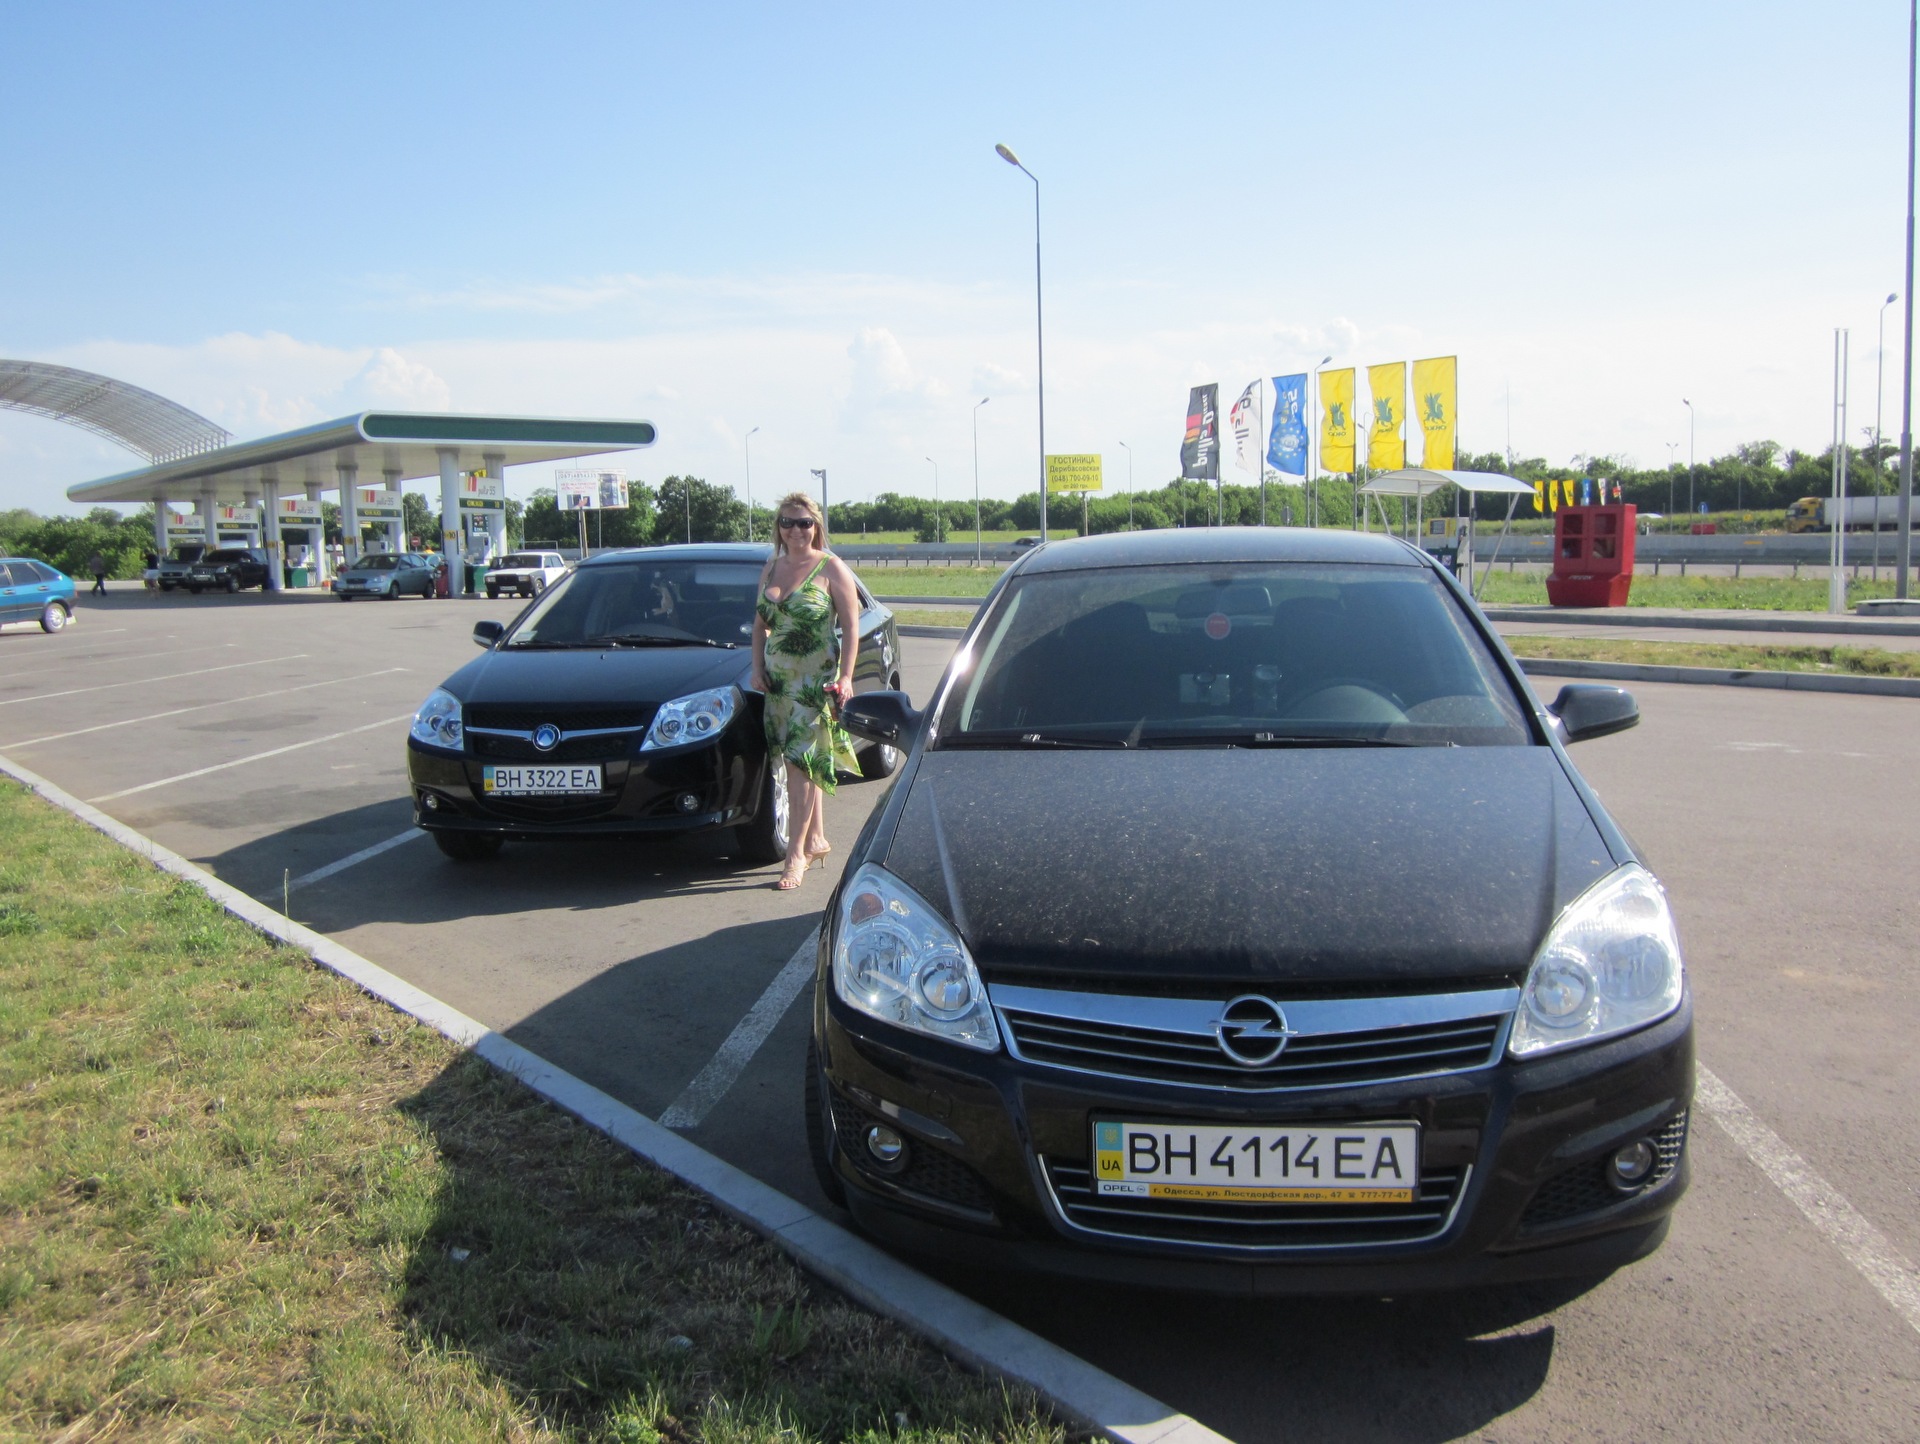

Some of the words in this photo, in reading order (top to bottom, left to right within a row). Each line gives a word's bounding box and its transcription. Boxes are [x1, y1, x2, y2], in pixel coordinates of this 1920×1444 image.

[1053, 456, 1095, 464] ГОСТИНИЦА
[496, 770, 521, 788] BH
[526, 770, 566, 788] 3322
[571, 769, 597, 788] EA
[1128, 1132, 1197, 1176] BH
[1209, 1135, 1320, 1179] 4114
[1333, 1136, 1403, 1180] EA
[1101, 1159, 1121, 1172] UA
[1103, 1184, 1135, 1193] OPEL
[1164, 1187, 1204, 1197] Одесса,
[1330, 1191, 1342, 1199] 47
